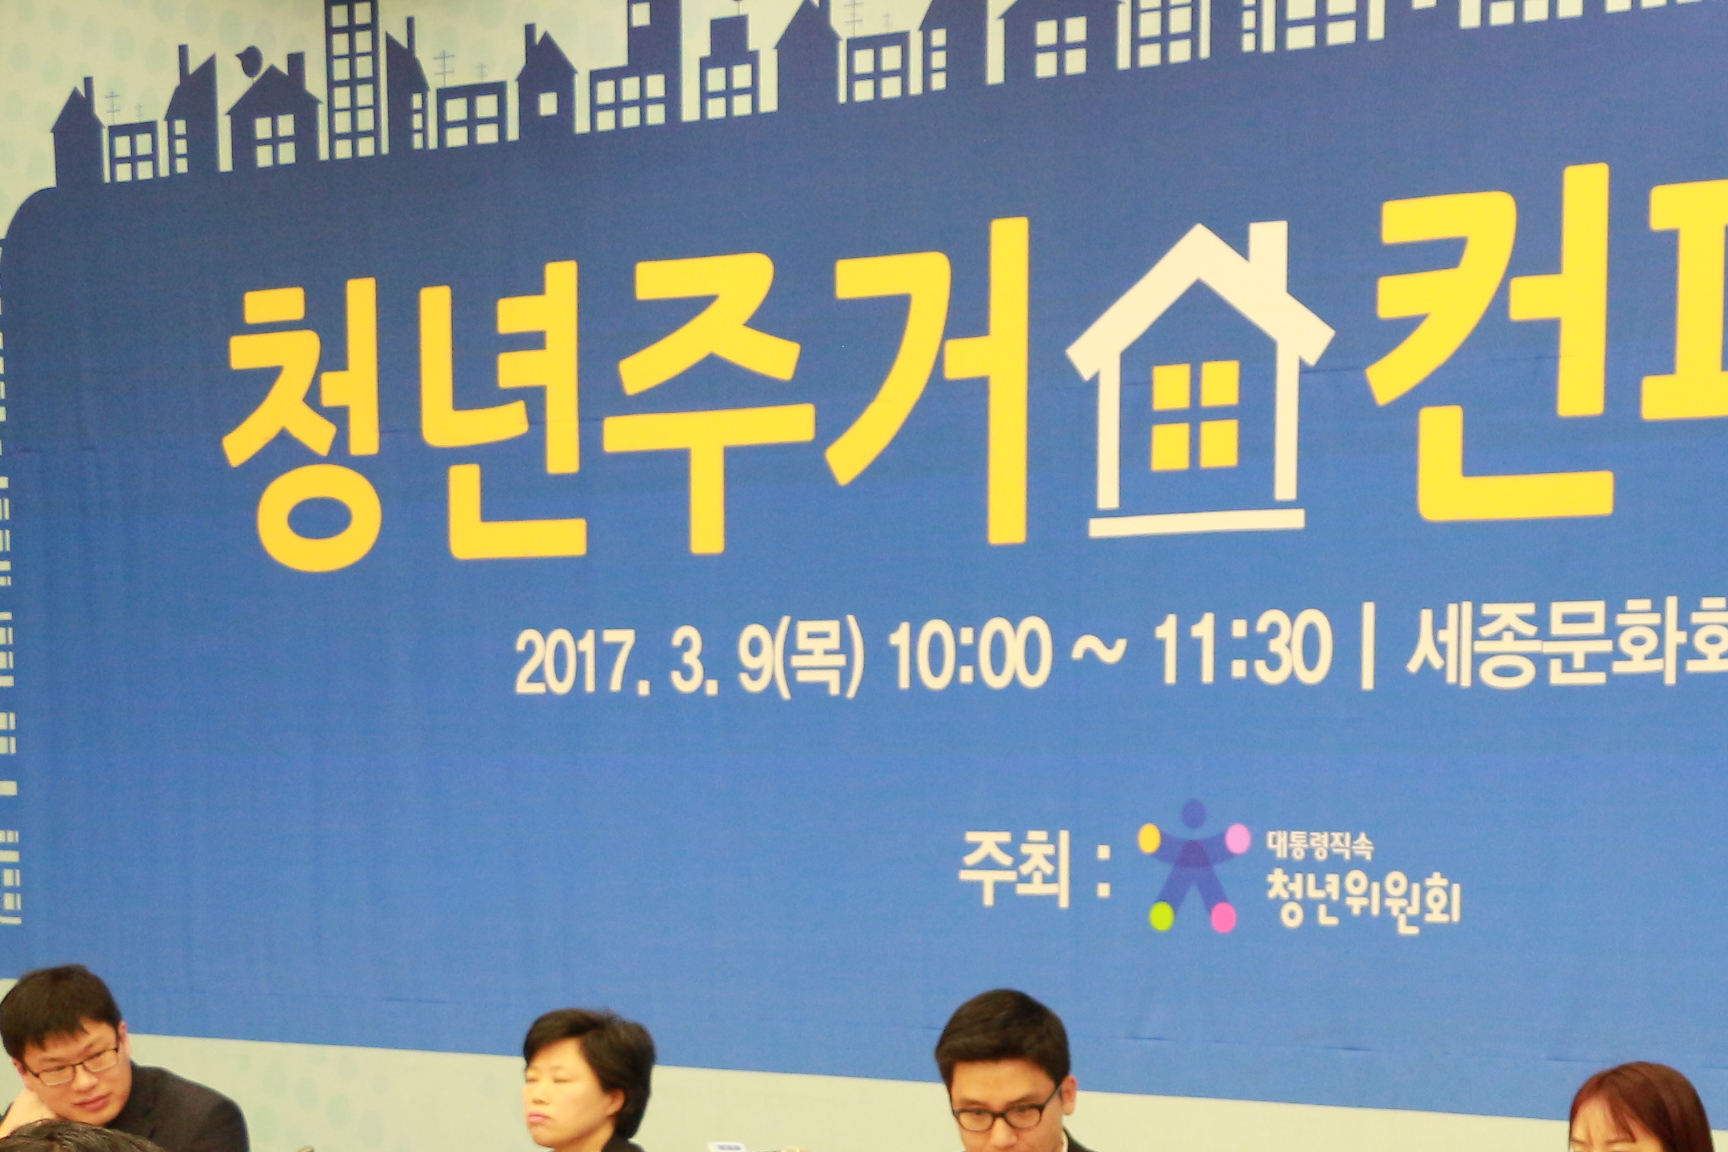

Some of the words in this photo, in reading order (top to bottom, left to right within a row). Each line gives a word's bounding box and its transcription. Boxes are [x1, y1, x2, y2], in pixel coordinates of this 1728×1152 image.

[220, 215, 1031, 574] 청년주거
[514, 627, 651, 698] 2017.
[669, 624, 720, 697] 3.
[737, 613, 866, 701] 9(목)
[887, 614, 1054, 692] 10:00
[1153, 607, 1335, 686] 11:30
[957, 828, 1071, 910] 주최
[1265, 829, 1376, 862] 대통령직속
[1266, 866, 1462, 937] 청년위원회
